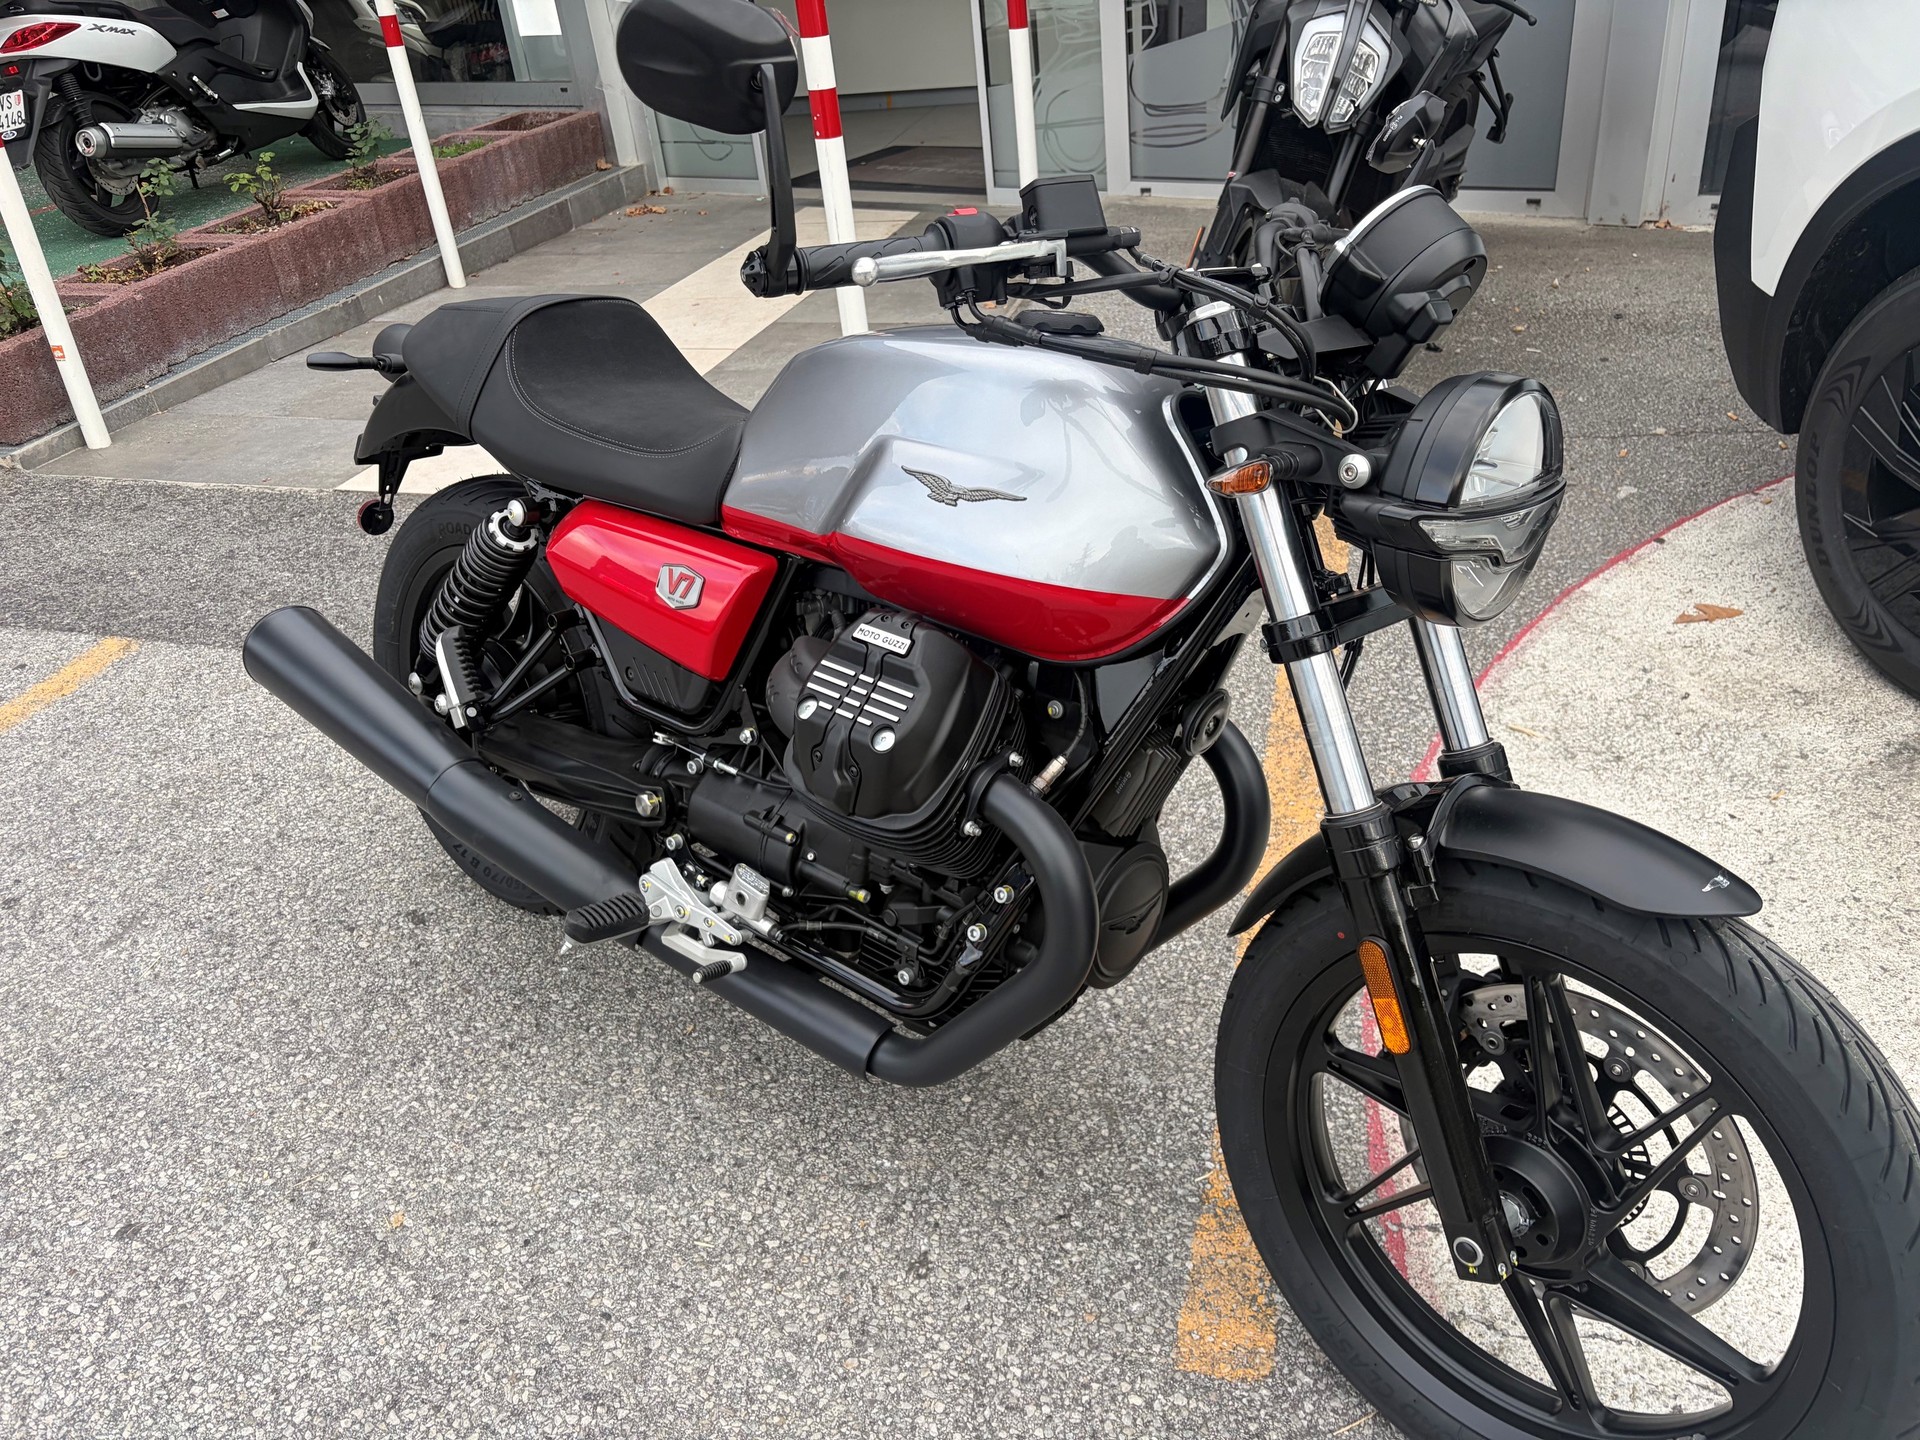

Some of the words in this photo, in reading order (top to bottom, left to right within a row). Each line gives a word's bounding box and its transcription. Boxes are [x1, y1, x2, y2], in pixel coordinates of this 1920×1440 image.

[1806, 432, 1832, 568] DUNLOP
[438, 521, 472, 536] ROAD
[668, 567, 696, 600] V7
[857, 627, 881, 641] MOTO
[881, 636, 908, 651] GUZZI
